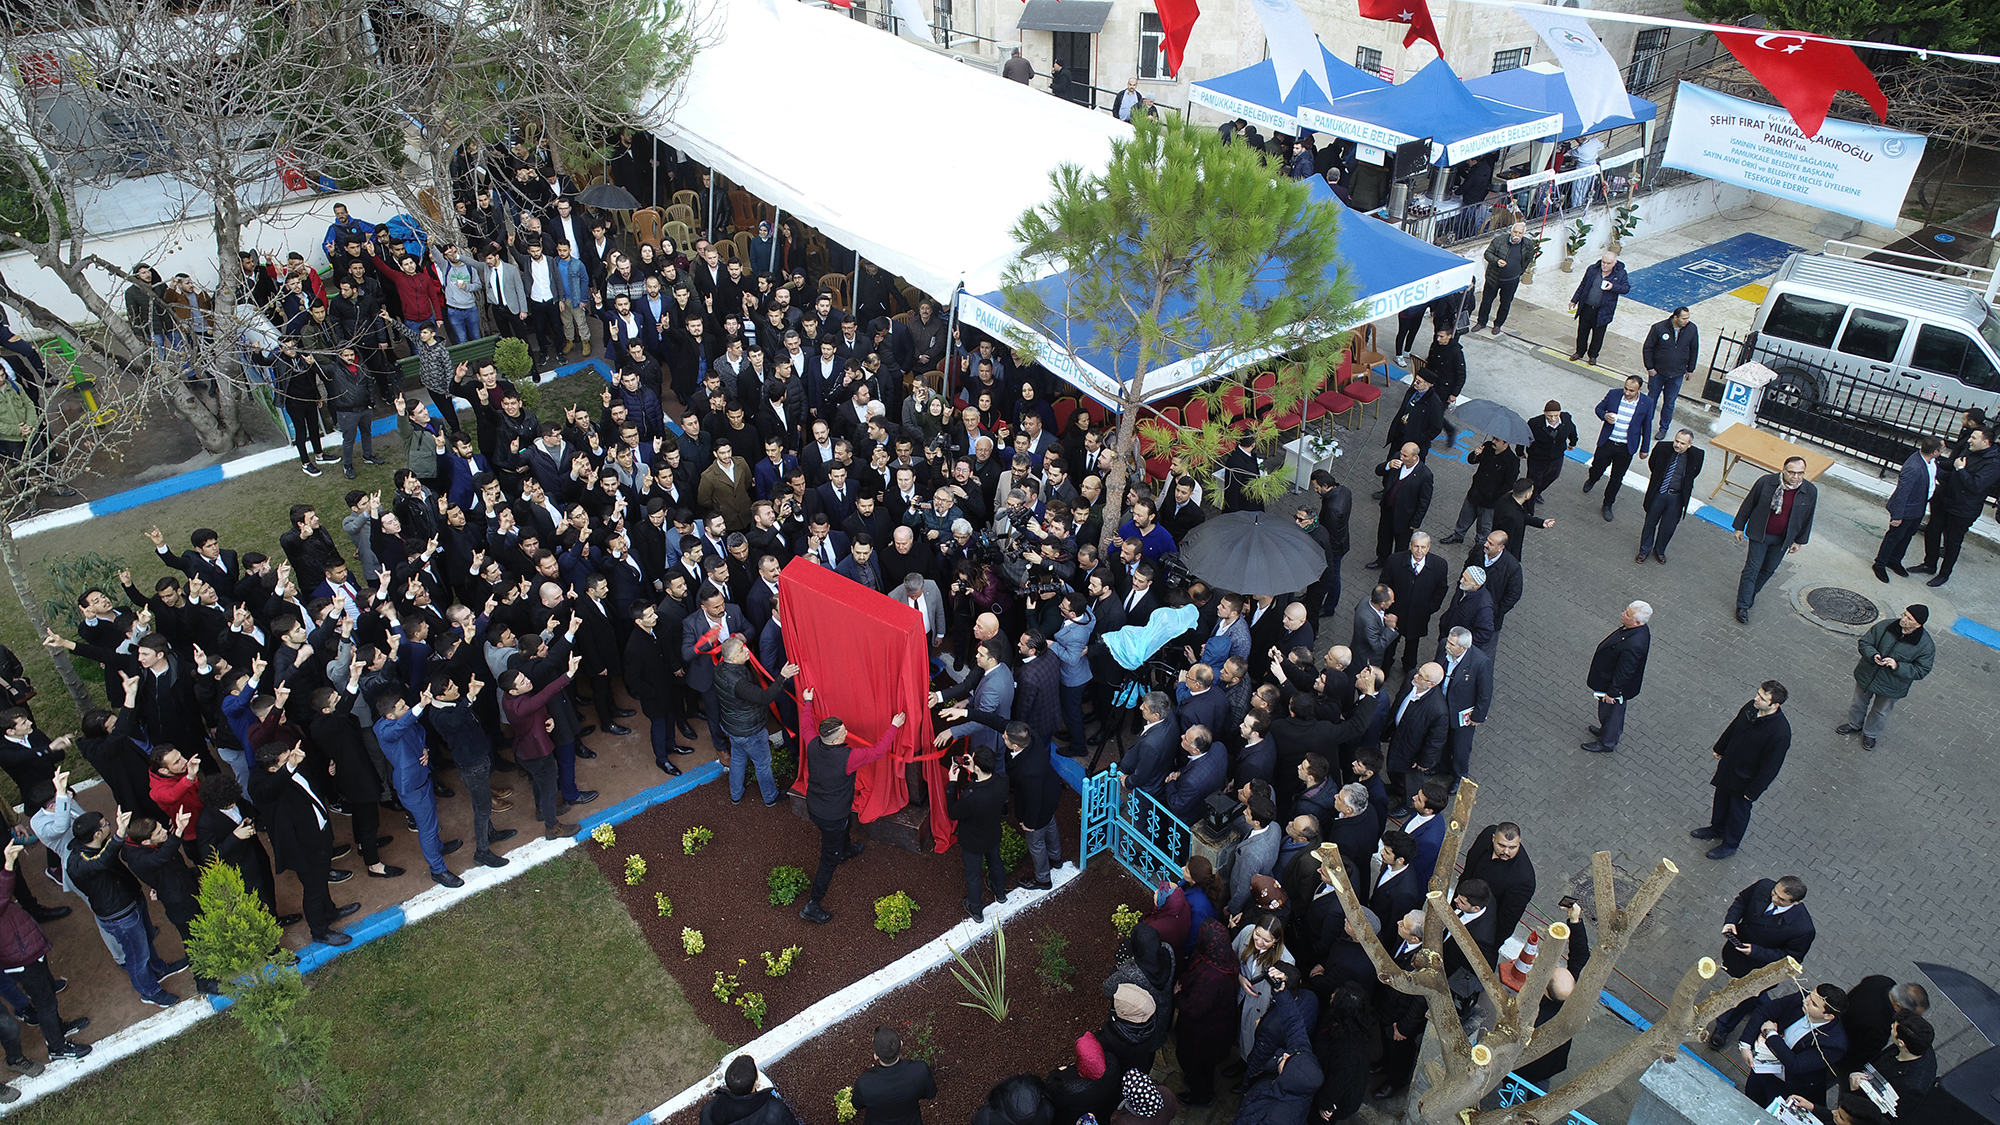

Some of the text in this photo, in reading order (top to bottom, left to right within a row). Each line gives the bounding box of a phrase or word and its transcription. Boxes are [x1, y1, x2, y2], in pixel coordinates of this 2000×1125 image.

[1200, 91, 1242, 115] PAMUKKALE
[1313, 114, 1369, 139] PAMUKKALE
[1710, 114, 1736, 128] ŞEHİT
[1739, 117, 1765, 130] FIRAT
[1809, 134, 1874, 163] ÇAKIROĞLU
[1460, 131, 1506, 156] PAMUKKALE
[1703, 149, 1723, 160] SAYIN
[1723, 155, 1740, 165] AVNİ
[1767, 166, 1797, 180] BELEDİYE
[1798, 175, 1823, 187] MECLİS
[1824, 180, 1862, 197] ÜYELERİNE
[1730, 147, 1835, 179] PAMUKKALE BELEDİYE BAŞKANI
[1799, 155, 1840, 172] SAĞLAYAN,
[1744, 170, 1810, 195] TEŞEKKÜR EDERİZ
[1721, 406, 1745, 417] OTOPARK
